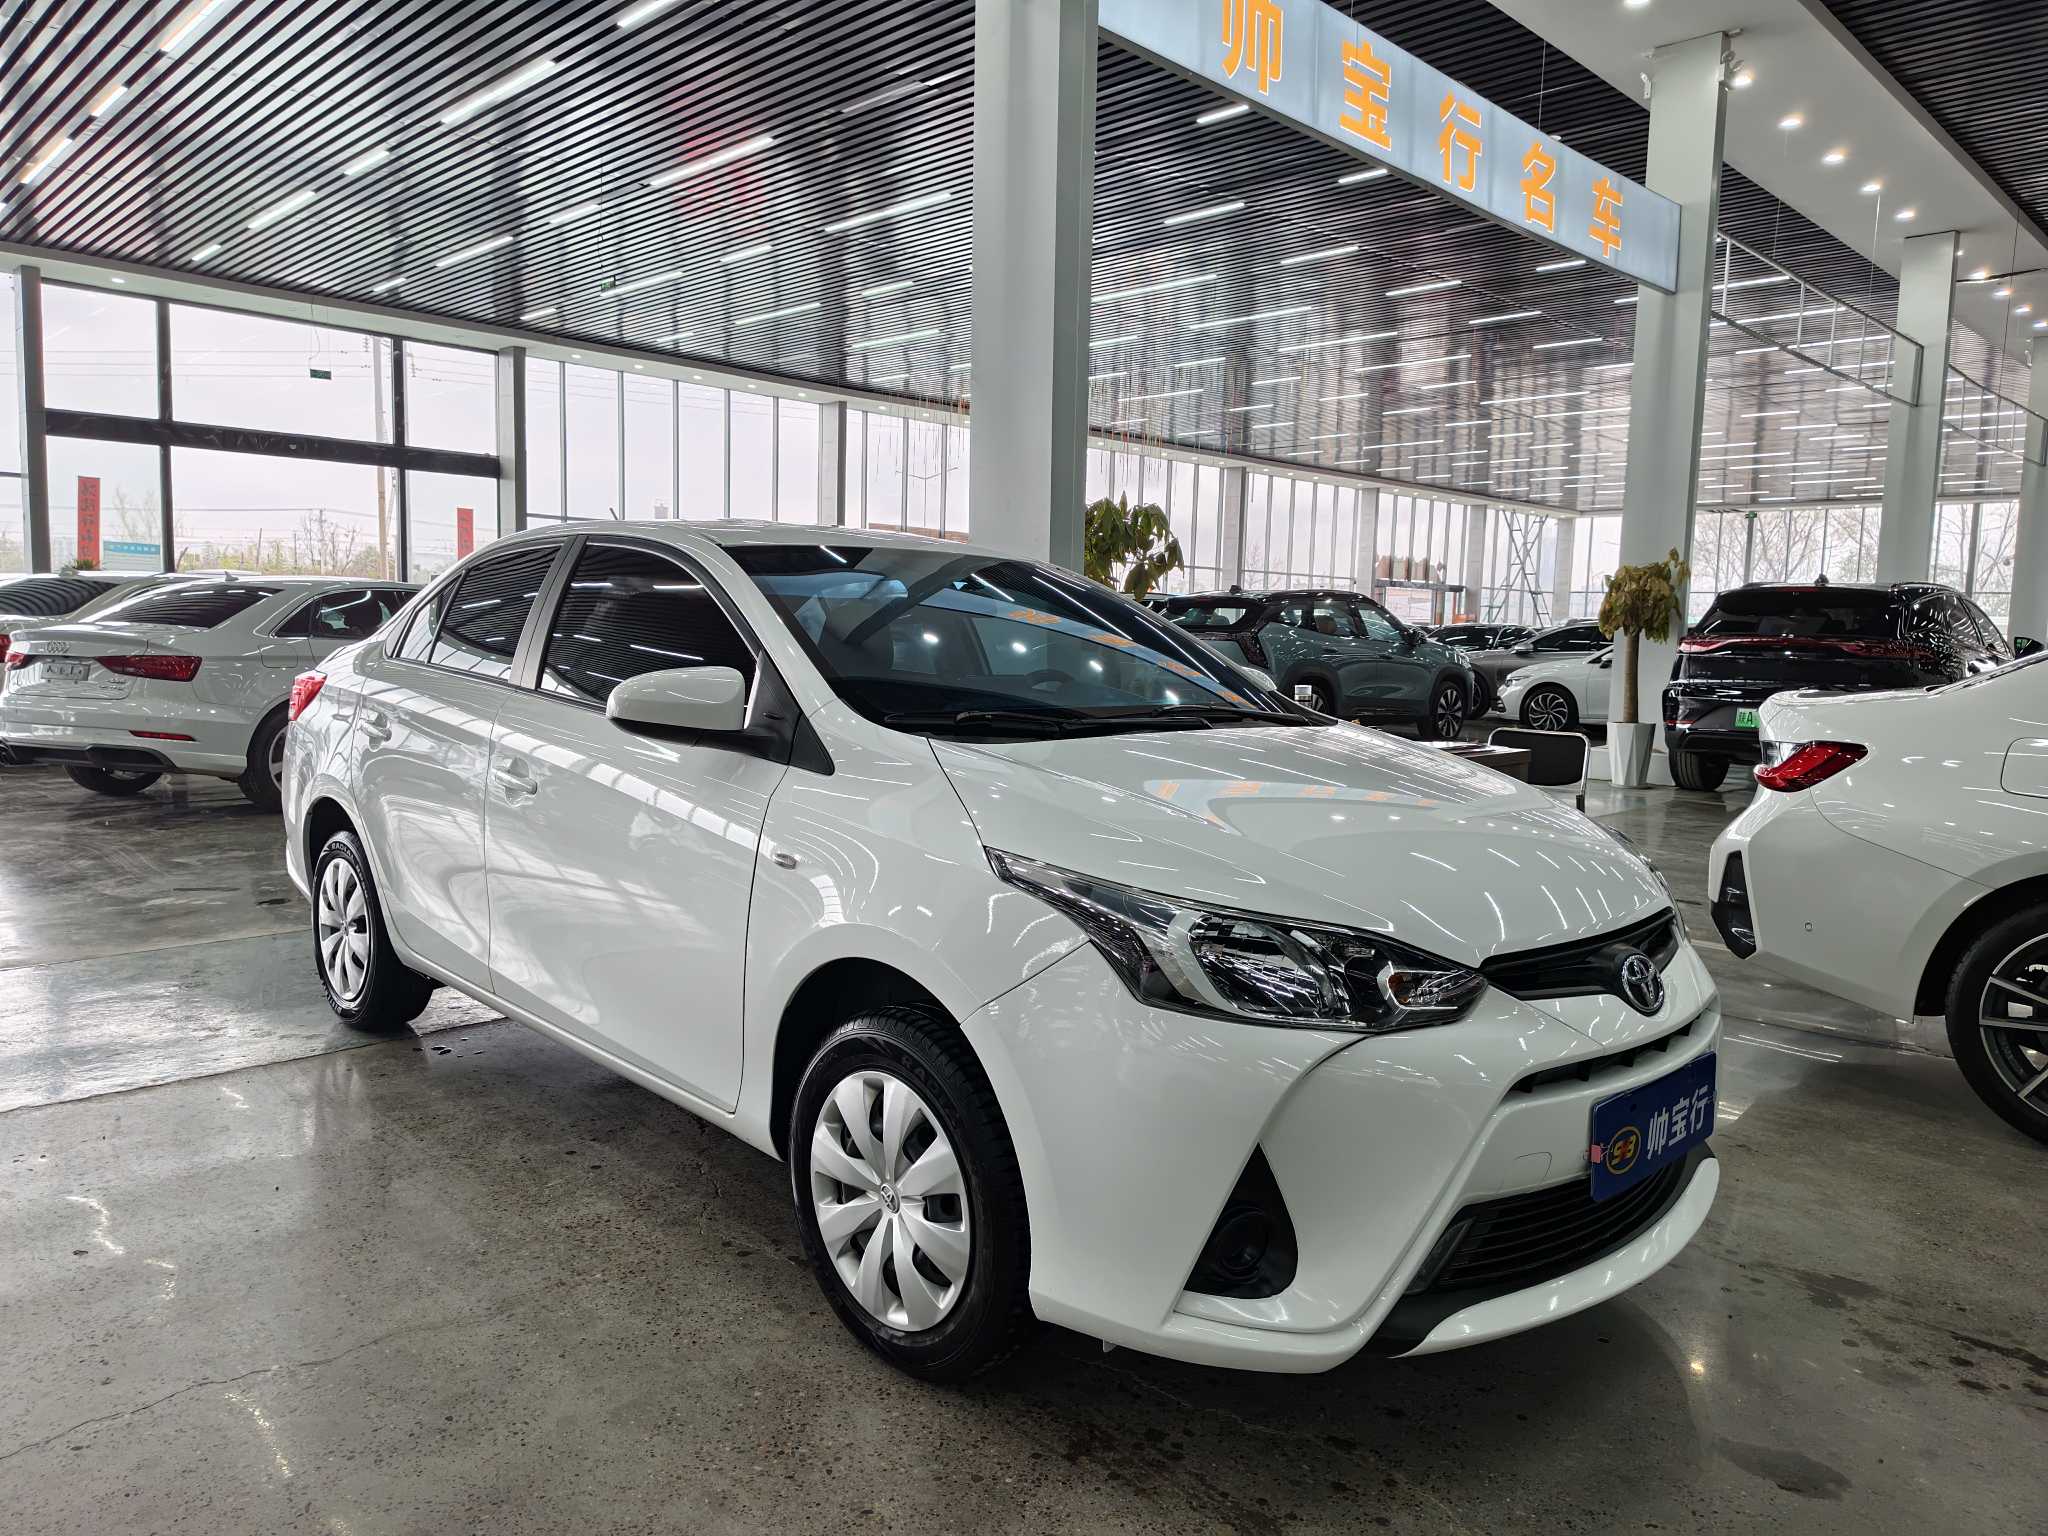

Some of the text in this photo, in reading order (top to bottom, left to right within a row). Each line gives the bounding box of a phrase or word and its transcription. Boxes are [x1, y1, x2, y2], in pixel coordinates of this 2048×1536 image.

[1220, 0, 1623, 258] 帅宝行名车
[1647, 1084, 1712, 1160] 帅宝行
